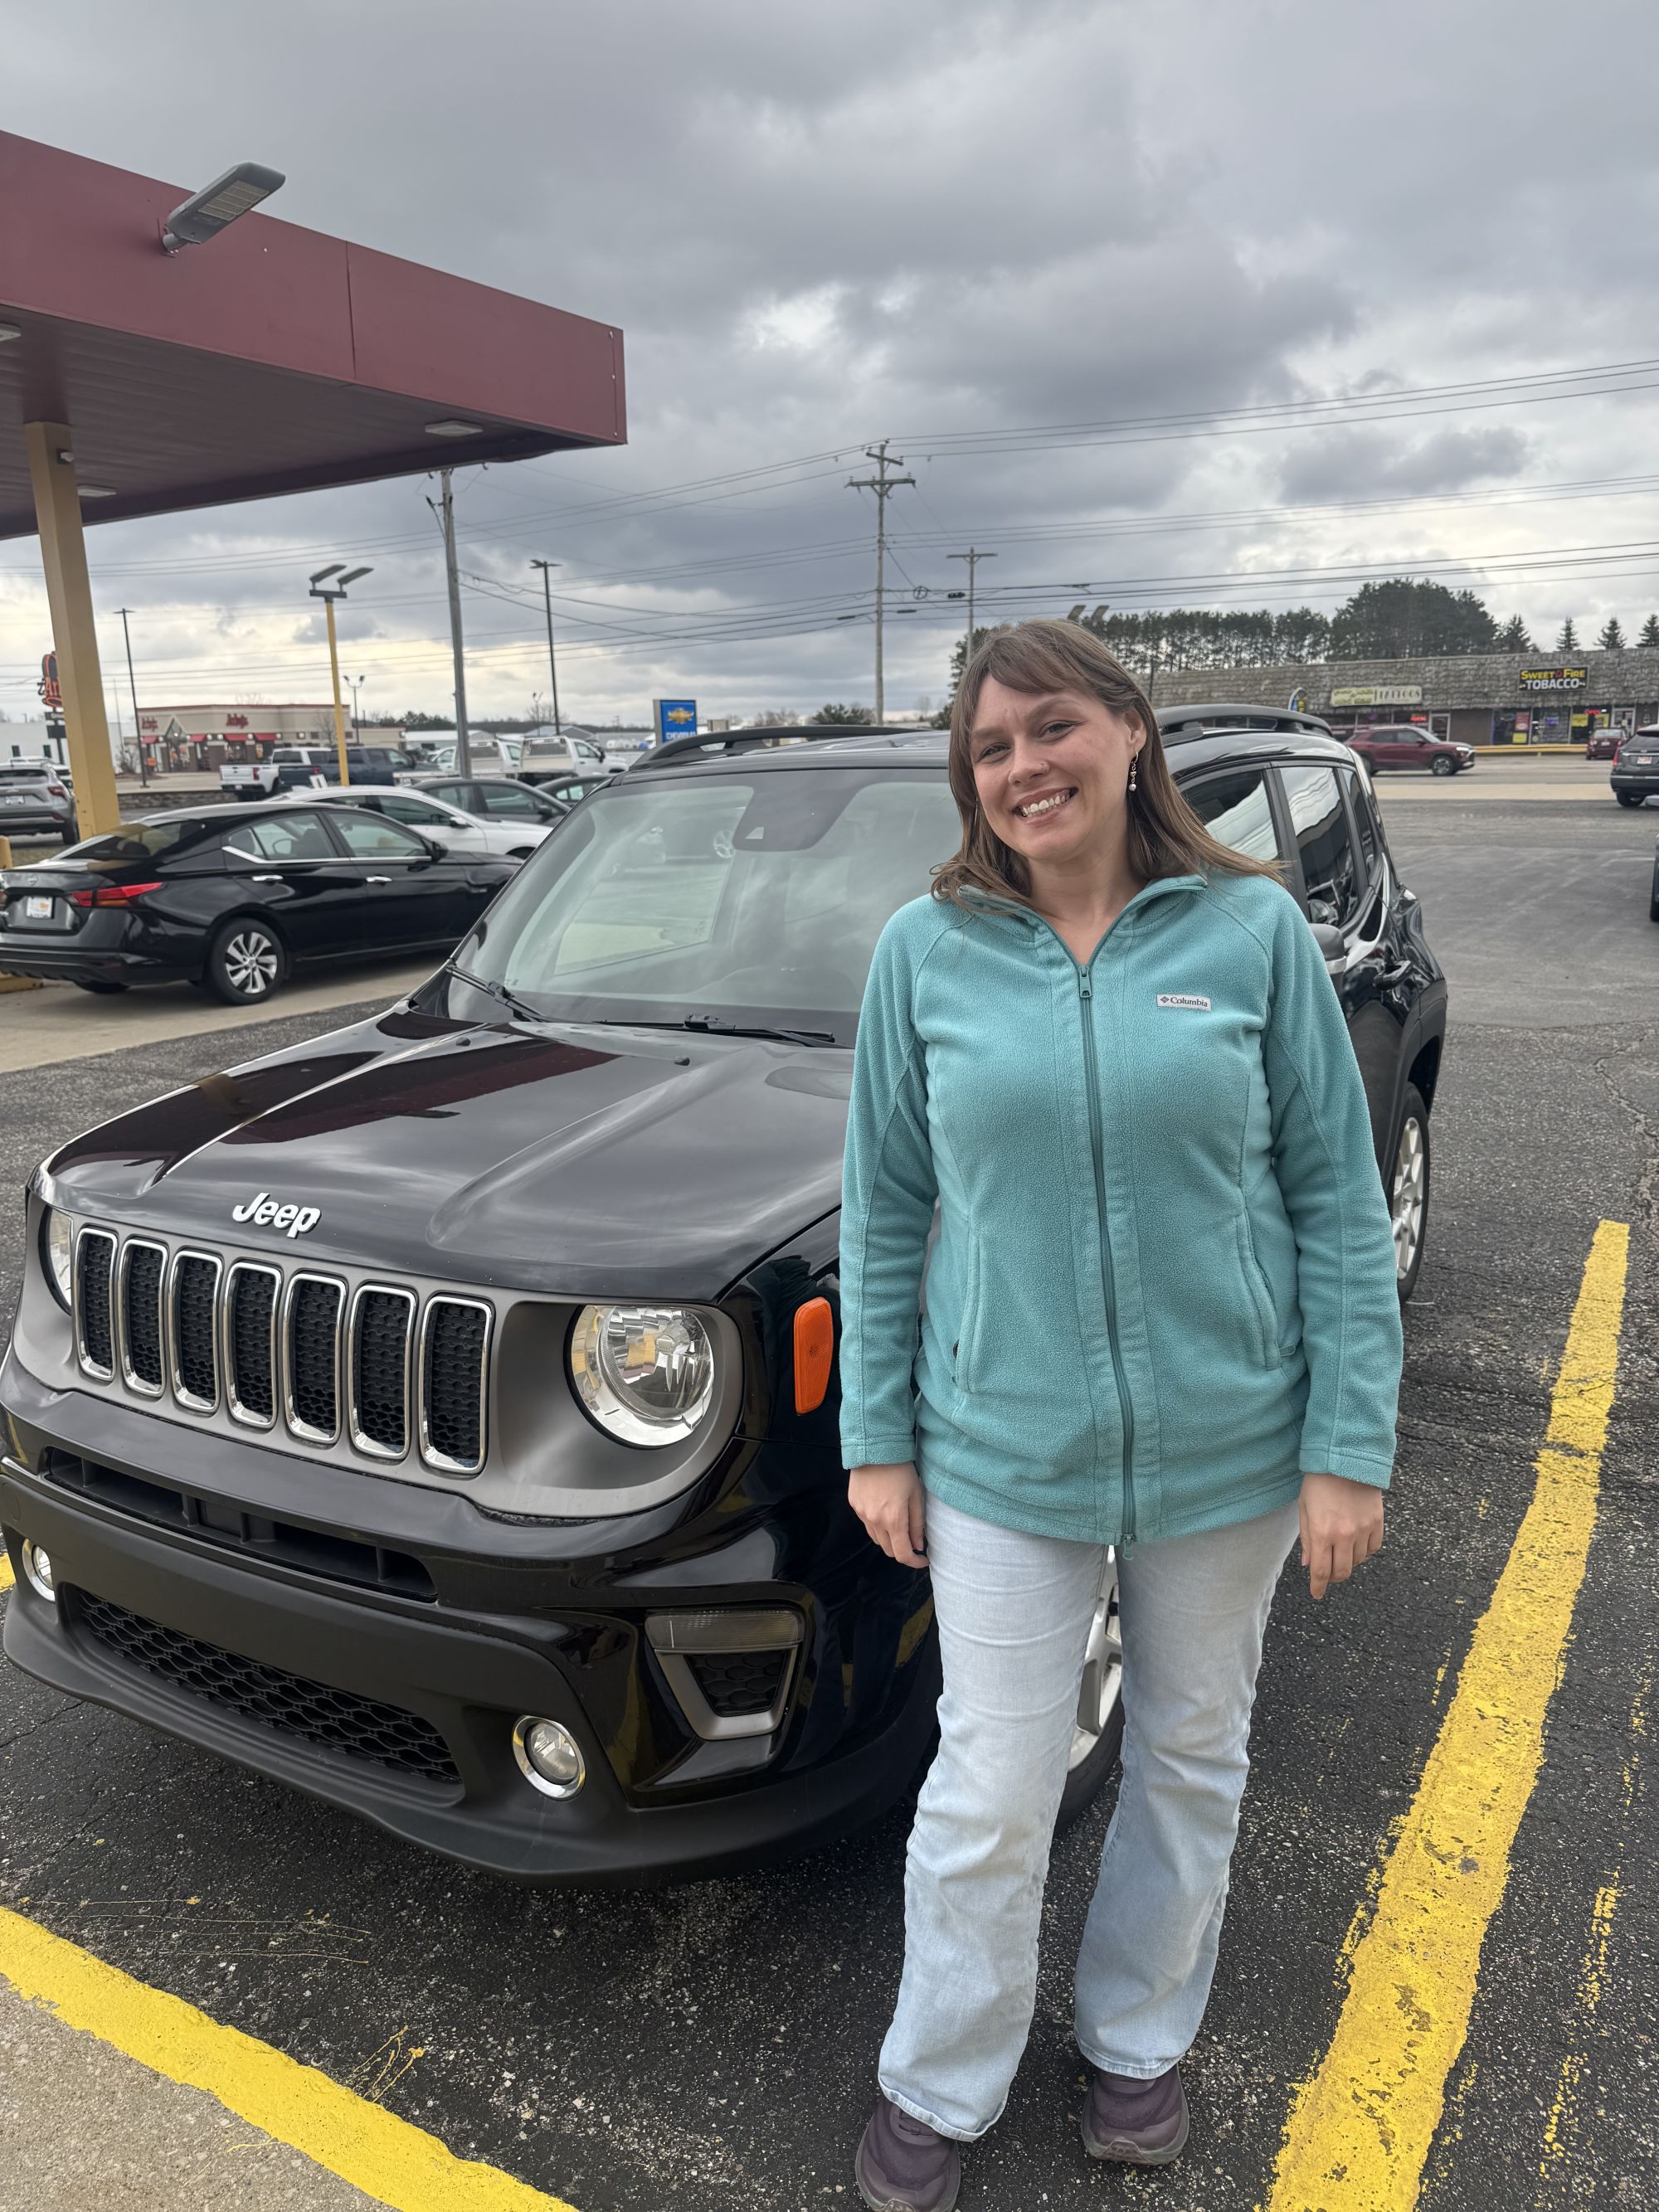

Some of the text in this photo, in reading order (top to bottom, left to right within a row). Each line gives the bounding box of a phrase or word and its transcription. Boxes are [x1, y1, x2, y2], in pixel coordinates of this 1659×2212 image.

[1520, 668, 1585, 679] SWEET FIRE
[1526, 678, 1579, 690] TOBACCO
[1170, 996, 1208, 1007] Columbia
[232, 1192, 321, 1239] Jeep
